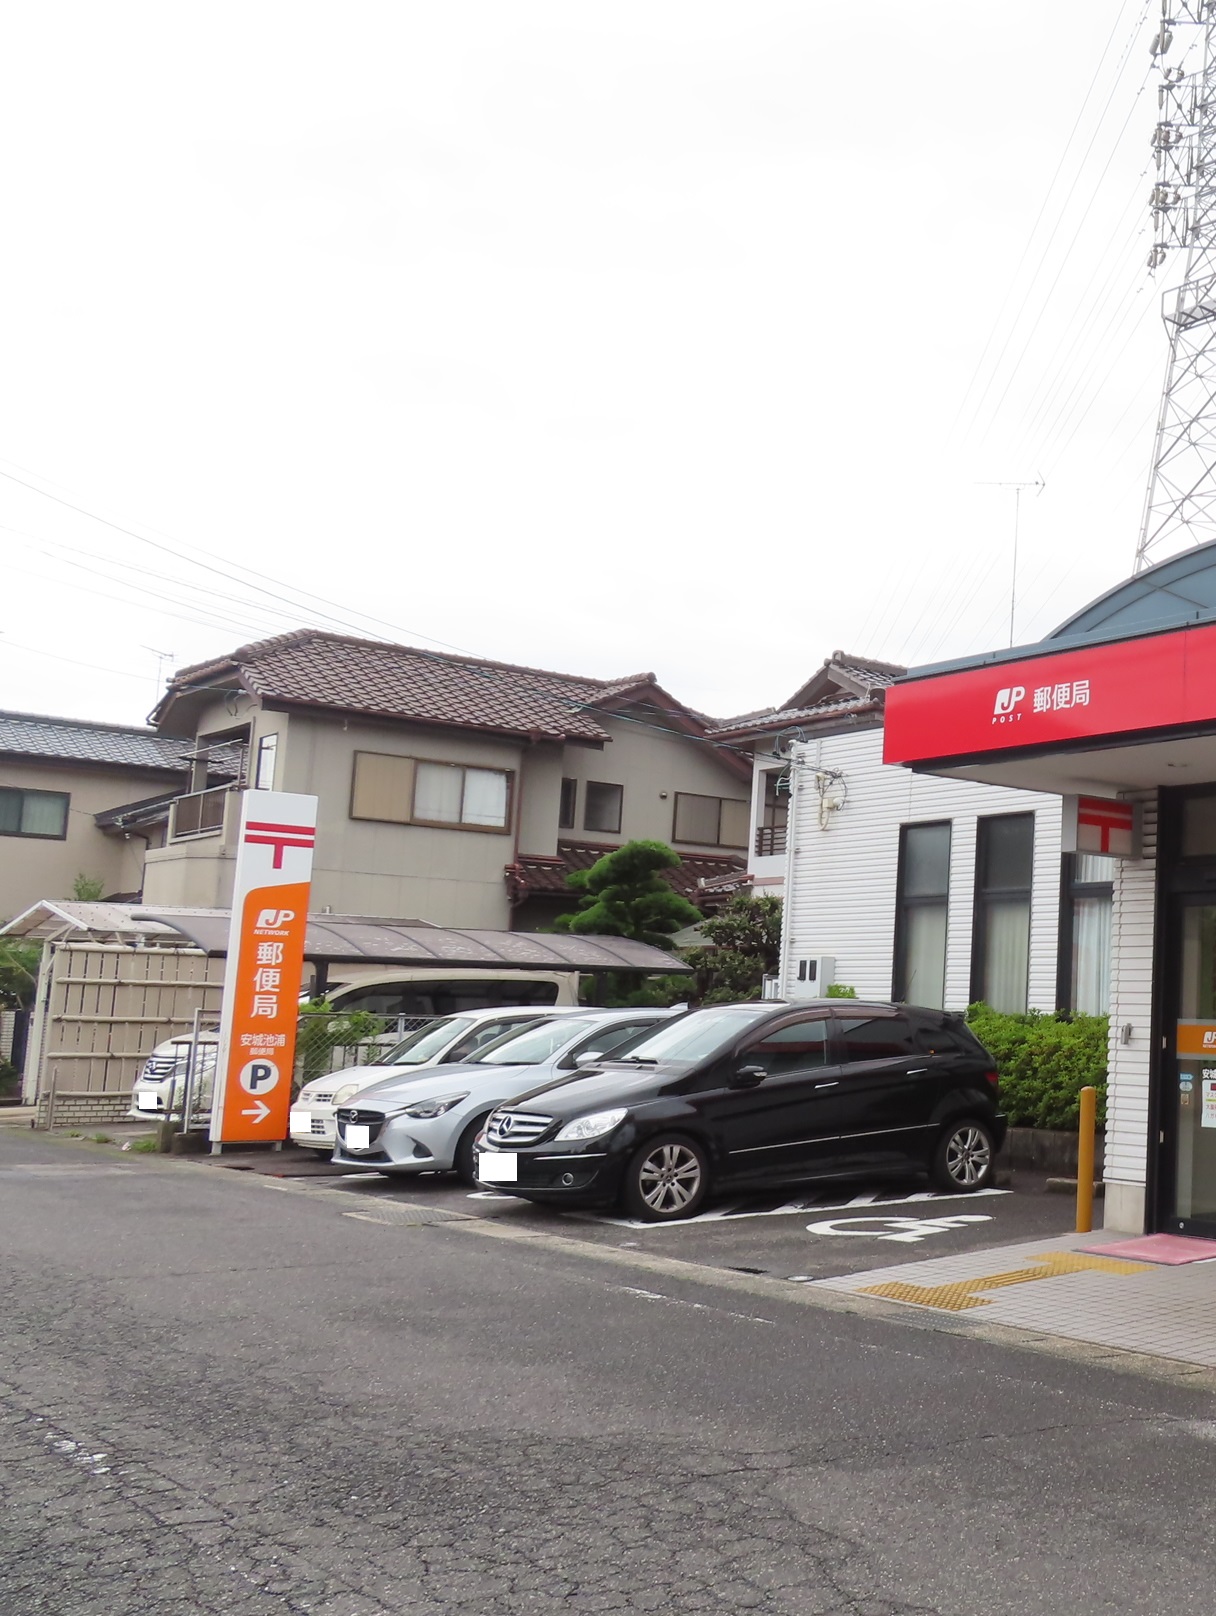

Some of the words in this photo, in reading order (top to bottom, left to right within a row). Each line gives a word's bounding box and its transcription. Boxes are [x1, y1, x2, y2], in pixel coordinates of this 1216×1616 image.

[1033, 680, 1090, 713] 郵便局
[991, 713, 1022, 725] POST
[251, 941, 285, 1019] 郵便局
[240, 1033, 286, 1047] 安城池浦
[249, 1047, 274, 1056] 郵便局
[250, 1064, 272, 1090] P
